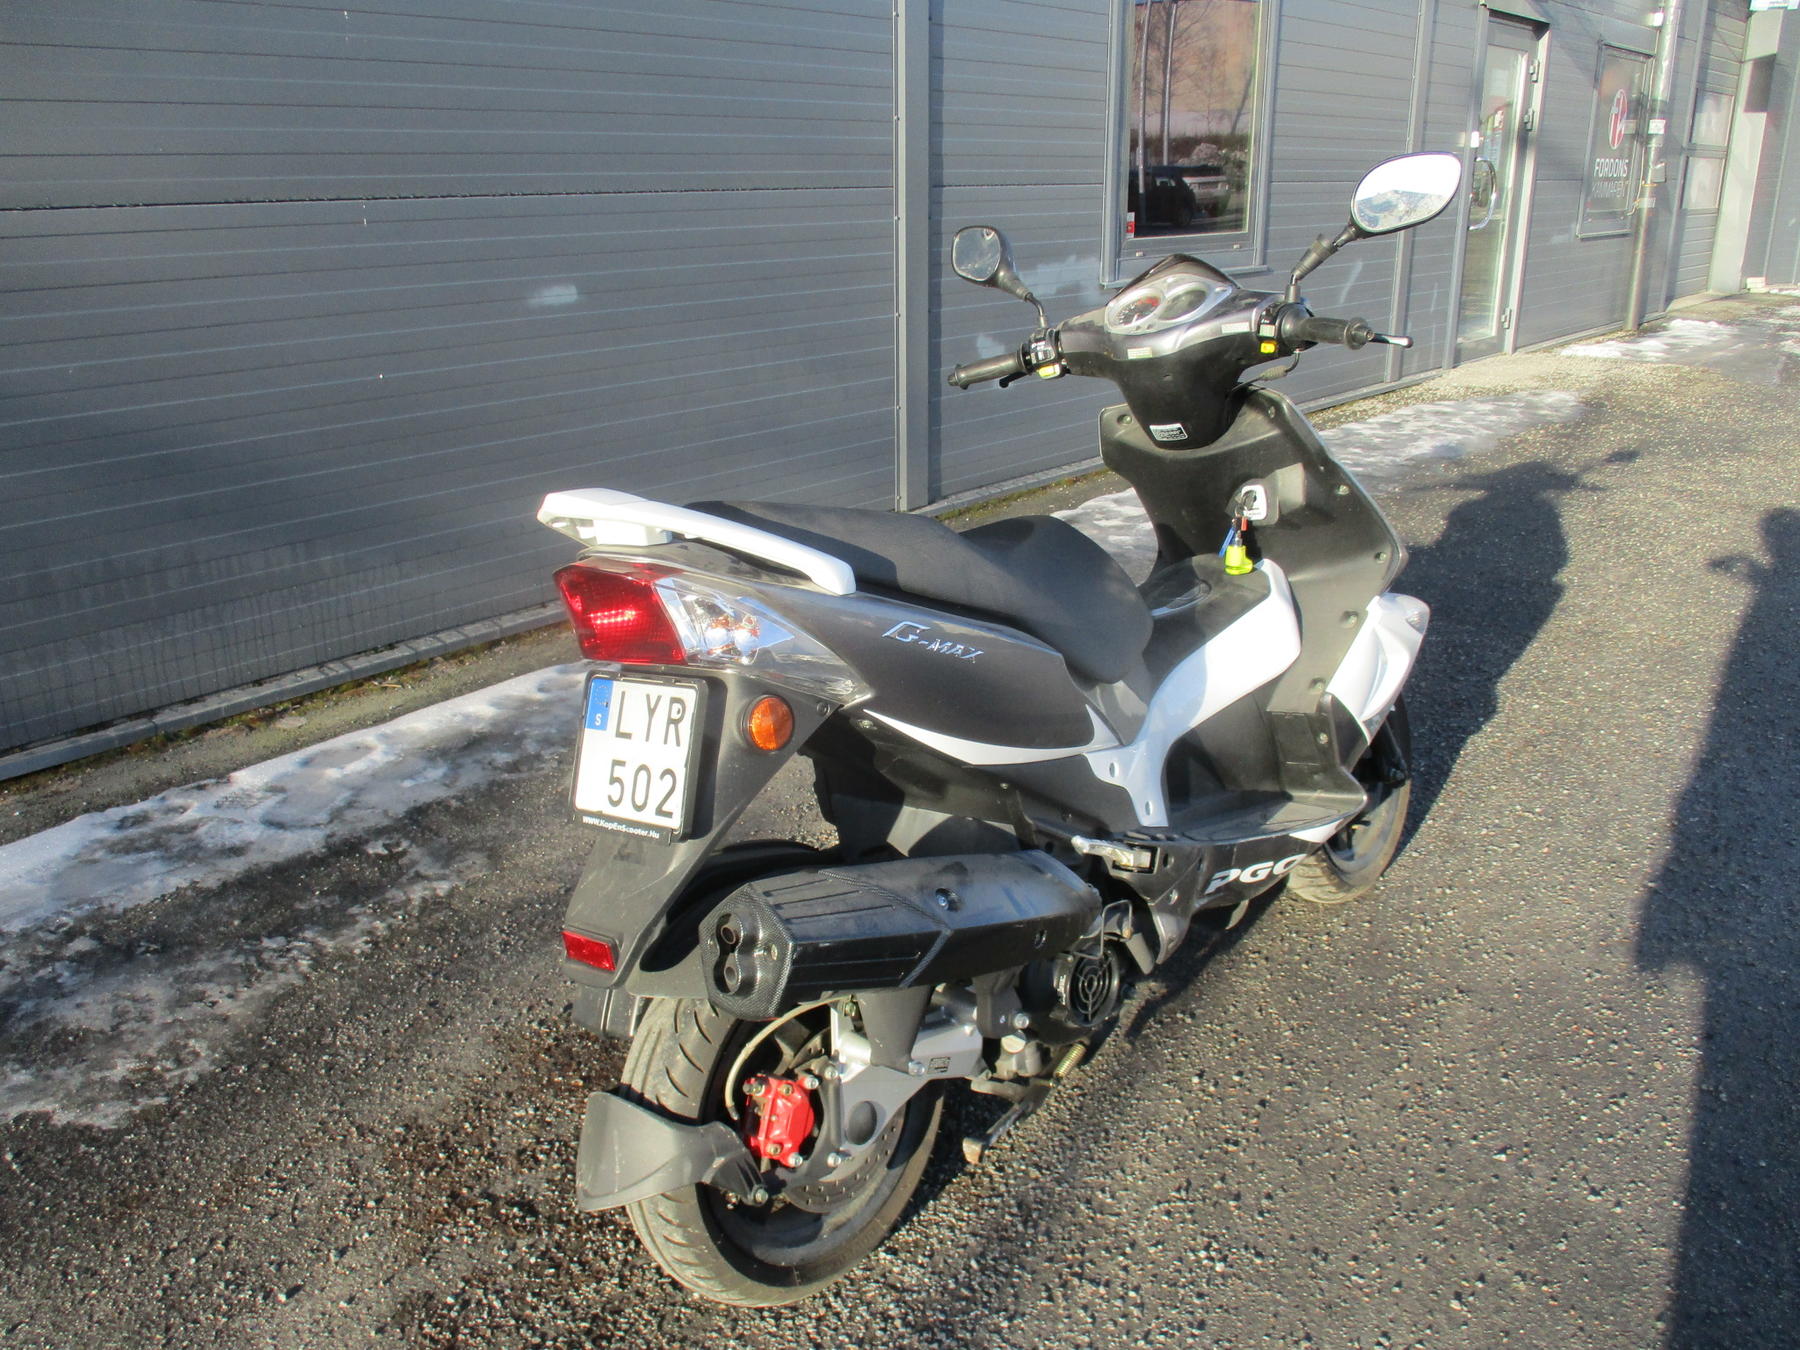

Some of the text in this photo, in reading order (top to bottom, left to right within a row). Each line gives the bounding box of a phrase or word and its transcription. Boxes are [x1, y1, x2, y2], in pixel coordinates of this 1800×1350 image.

[1593, 158, 1629, 177] FORDONS
[881, 621, 984, 663] G-MAX
[594, 713, 602, 727] S
[615, 691, 687, 747] LYR
[607, 759, 678, 819] 502
[1203, 853, 1309, 895] PGO
